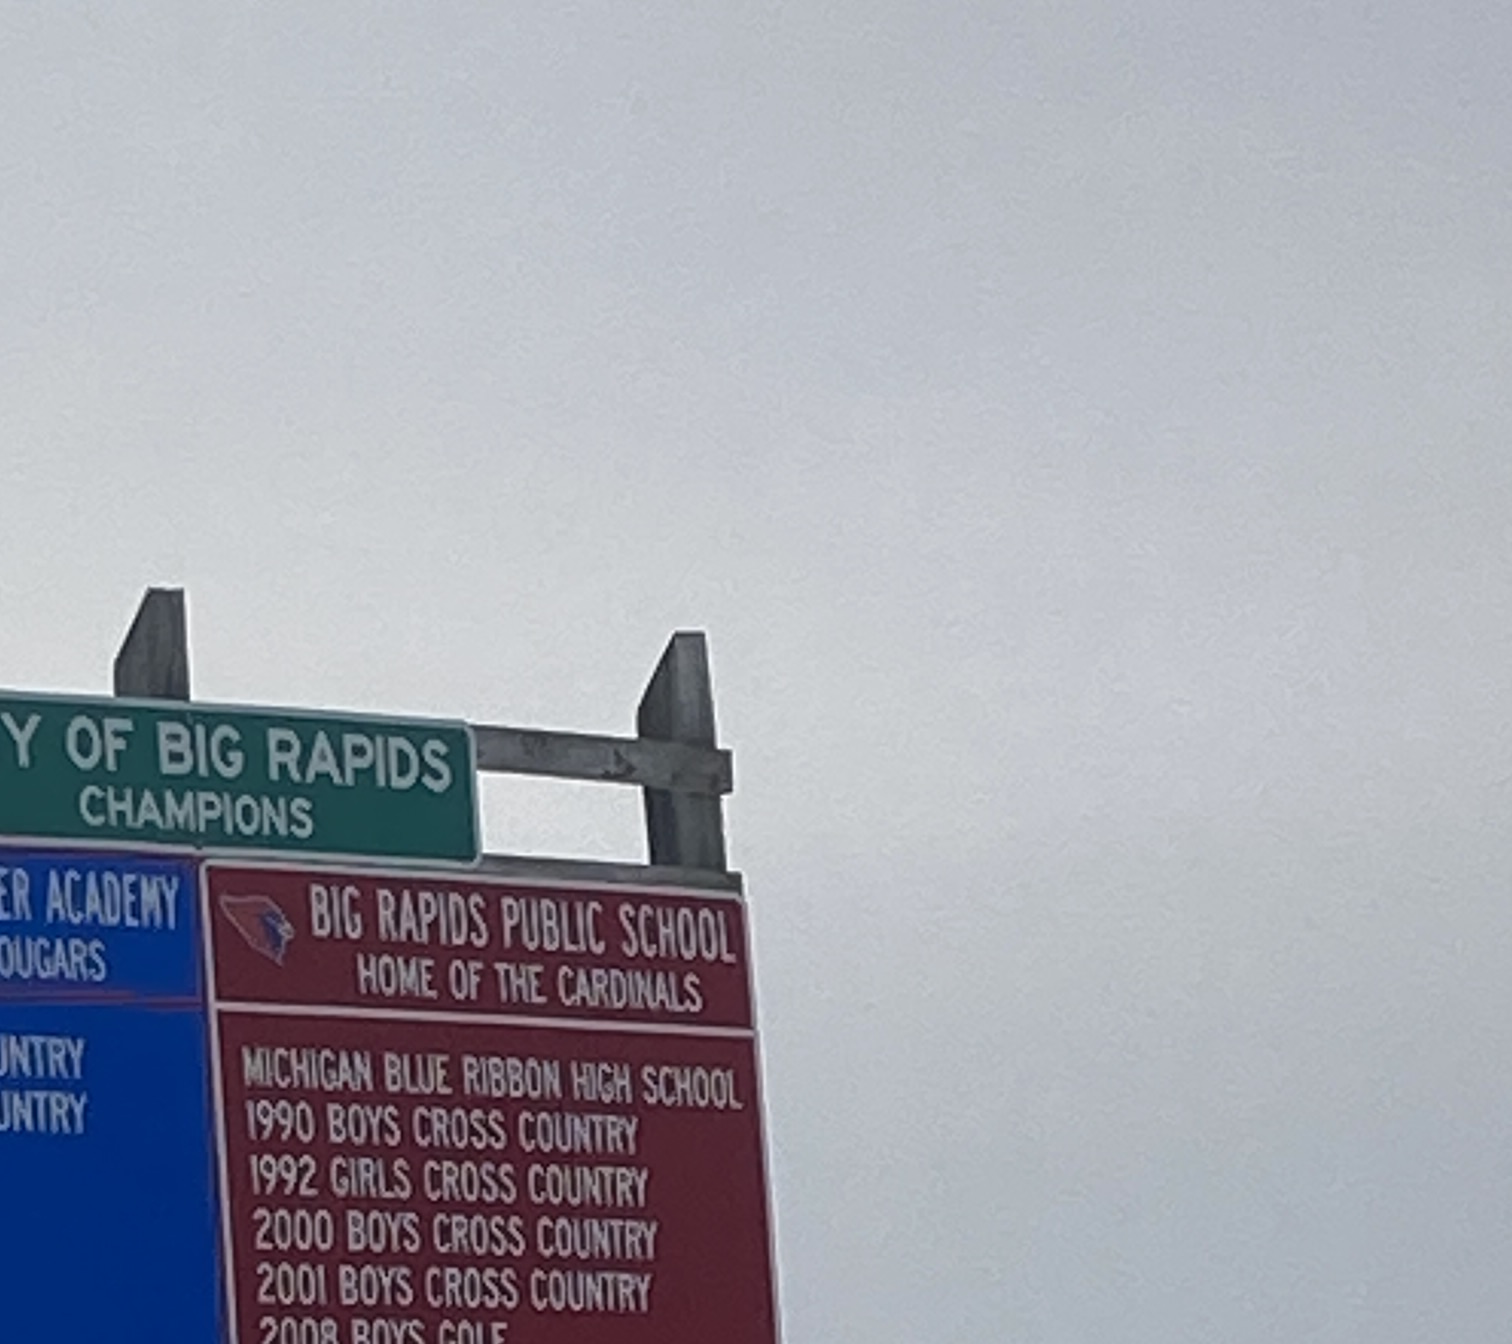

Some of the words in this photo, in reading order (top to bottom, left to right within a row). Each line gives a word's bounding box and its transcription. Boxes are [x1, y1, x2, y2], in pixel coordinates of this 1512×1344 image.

[67, 716, 133, 771] OF
[157, 722, 243, 777] BIG
[268, 728, 451, 792] RAPIDS
[80, 786, 313, 838] CHAMPIONS
[47, 870, 178, 929] ACADEMY
[311, 884, 362, 939] BIG
[377, 889, 488, 947] RAPIDS
[501, 897, 605, 954] PUBLIC
[619, 903, 736, 962] SCHOOL
[358, 954, 437, 999] HOME
[449, 960, 483, 1000] OF
[494, 963, 547, 1003] THE
[558, 966, 702, 1012] CARDINALS
[242, 1047, 373, 1091] MICHIGAN
[384, 1052, 452, 1094] BLUE
[462, 1055, 562, 1098] RIBBON
[571, 1061, 632, 1103] HIGH
[642, 1066, 742, 1109] SCHOOL
[246, 1100, 314, 1143] 1990
[327, 1103, 400, 1146] BOYS
[413, 1106, 506, 1149] CROSS
[519, 1111, 638, 1154] COUNTRY
[251, 1154, 318, 1196] 1992
[330, 1156, 411, 1199] GIRLS
[424, 1160, 516, 1203] CROSS
[528, 1164, 647, 1206] COUNTRY
[253, 1208, 333, 1251] 2000
[347, 1210, 420, 1252] BOYS
[433, 1213, 525, 1256] CROSS
[537, 1216, 657, 1259] COUNTRY
[257, 1262, 326, 1304] 2001
[339, 1265, 413, 1305] BOYS
[426, 1267, 518, 1309] CROSS
[531, 1268, 651, 1312] COUNTRY
